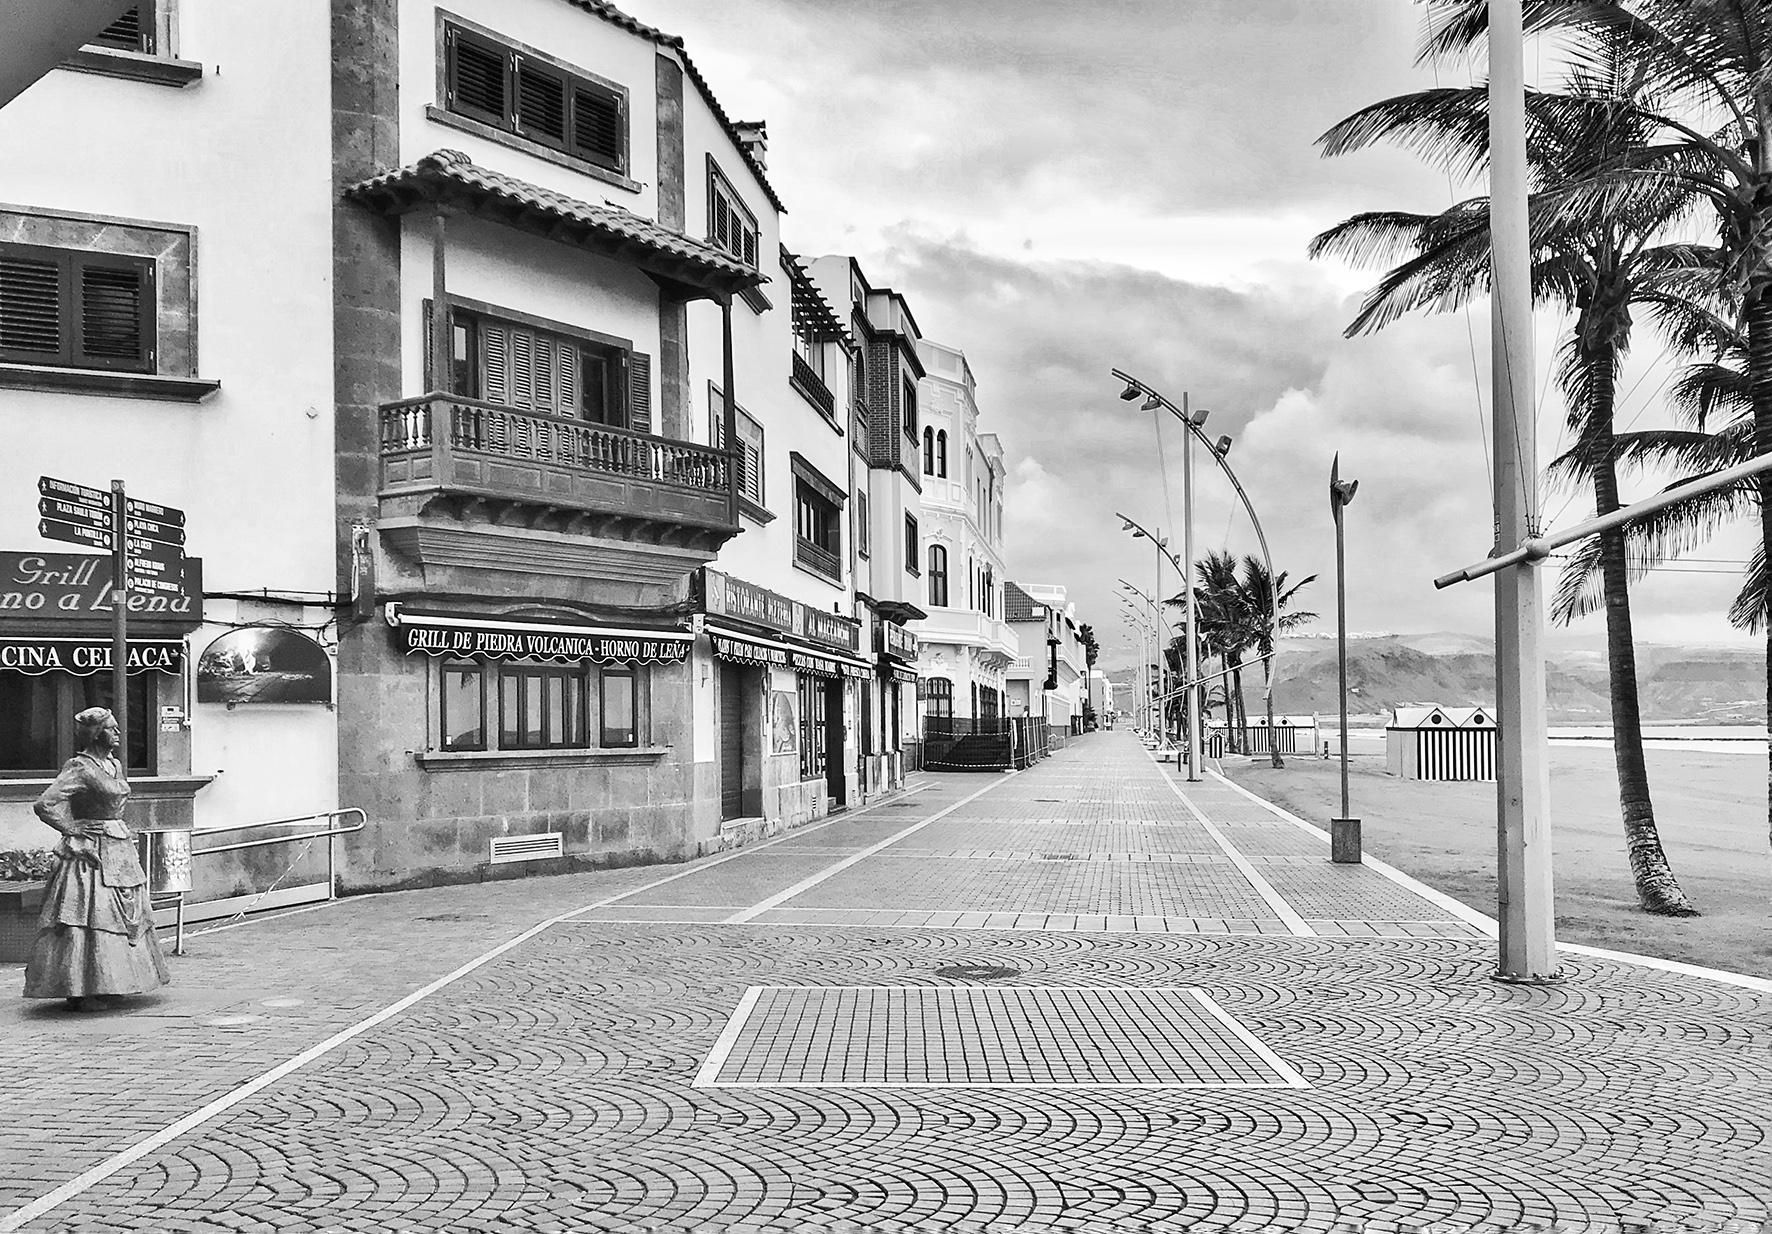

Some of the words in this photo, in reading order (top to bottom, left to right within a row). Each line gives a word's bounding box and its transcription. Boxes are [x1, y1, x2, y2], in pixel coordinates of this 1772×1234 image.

[56, 501, 74, 514] PLAZA
[74, 526, 81, 536] LA
[12, 556, 100, 586] Grill
[58, 593, 81, 610] a
[408, 628, 449, 649] GRILL
[453, 632, 472, 650] DE
[476, 633, 524, 653] PIEDRA
[527, 636, 594, 656] VOLCANICA
[600, 640, 639, 658] HORNO
[643, 642, 658, 658] DE
[659, 640, 685, 658] LEÑA
